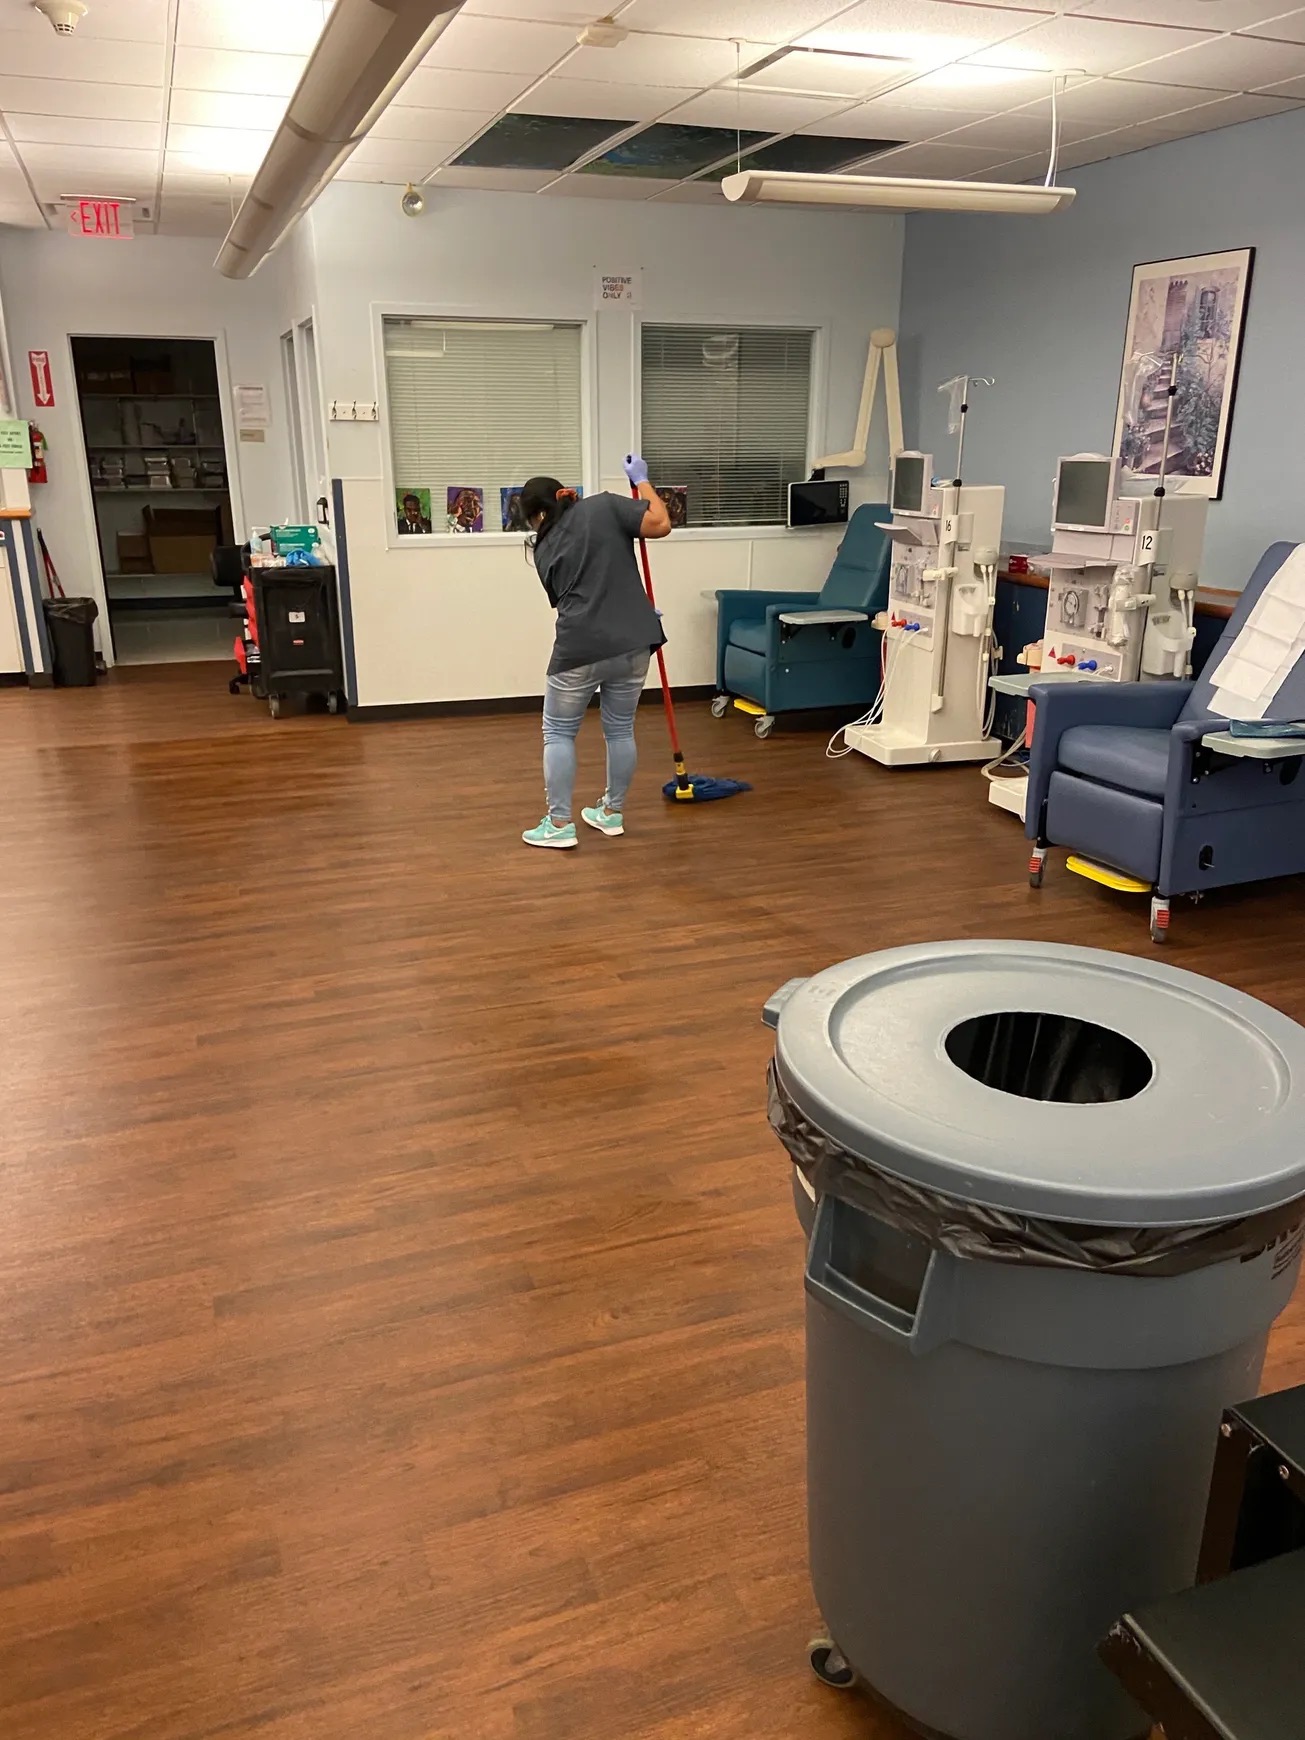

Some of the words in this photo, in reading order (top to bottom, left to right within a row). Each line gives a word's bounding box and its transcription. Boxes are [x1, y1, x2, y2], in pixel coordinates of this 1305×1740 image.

[80, 201, 120, 235] EXIT
[601, 276, 632, 284] POSITIVE
[602, 284, 624, 292] VIBES
[1141, 535, 1153, 550] 12
